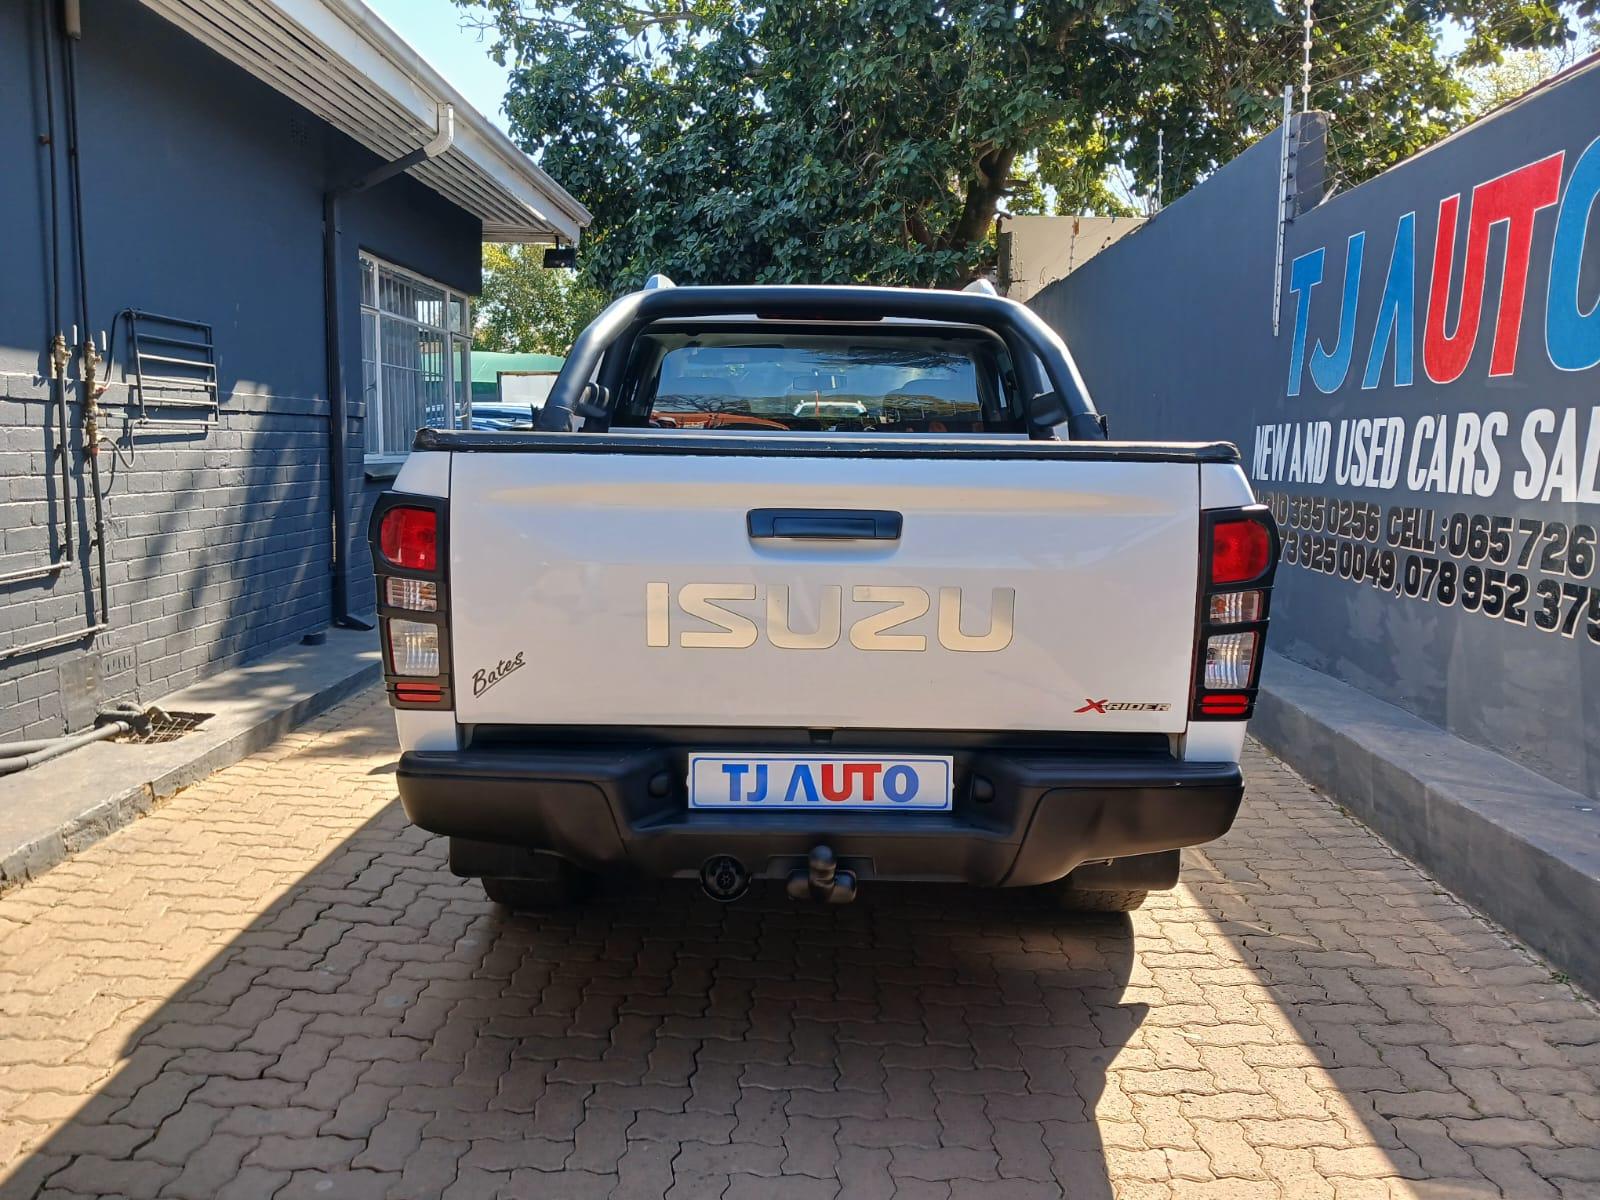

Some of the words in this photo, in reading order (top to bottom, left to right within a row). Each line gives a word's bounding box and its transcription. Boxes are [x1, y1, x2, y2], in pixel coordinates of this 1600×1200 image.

[1287, 231, 1365, 395] TJ
[1252, 423, 1292, 482] NEW
[1288, 421, 1332, 485] AND
[1335, 417, 1405, 489] USED
[1407, 411, 1509, 497] CARS
[1327, 498, 1381, 543] 0256
[1386, 506, 1437, 554] CELL
[1517, 518, 1597, 580] 726
[646, 582, 1015, 652] ISUZU
[1301, 534, 1338, 575] 925
[1462, 565, 1531, 627] 952
[472, 651, 525, 697] Bates
[722, 763, 768, 802] TJ
[784, 763, 919, 803] AUTO
